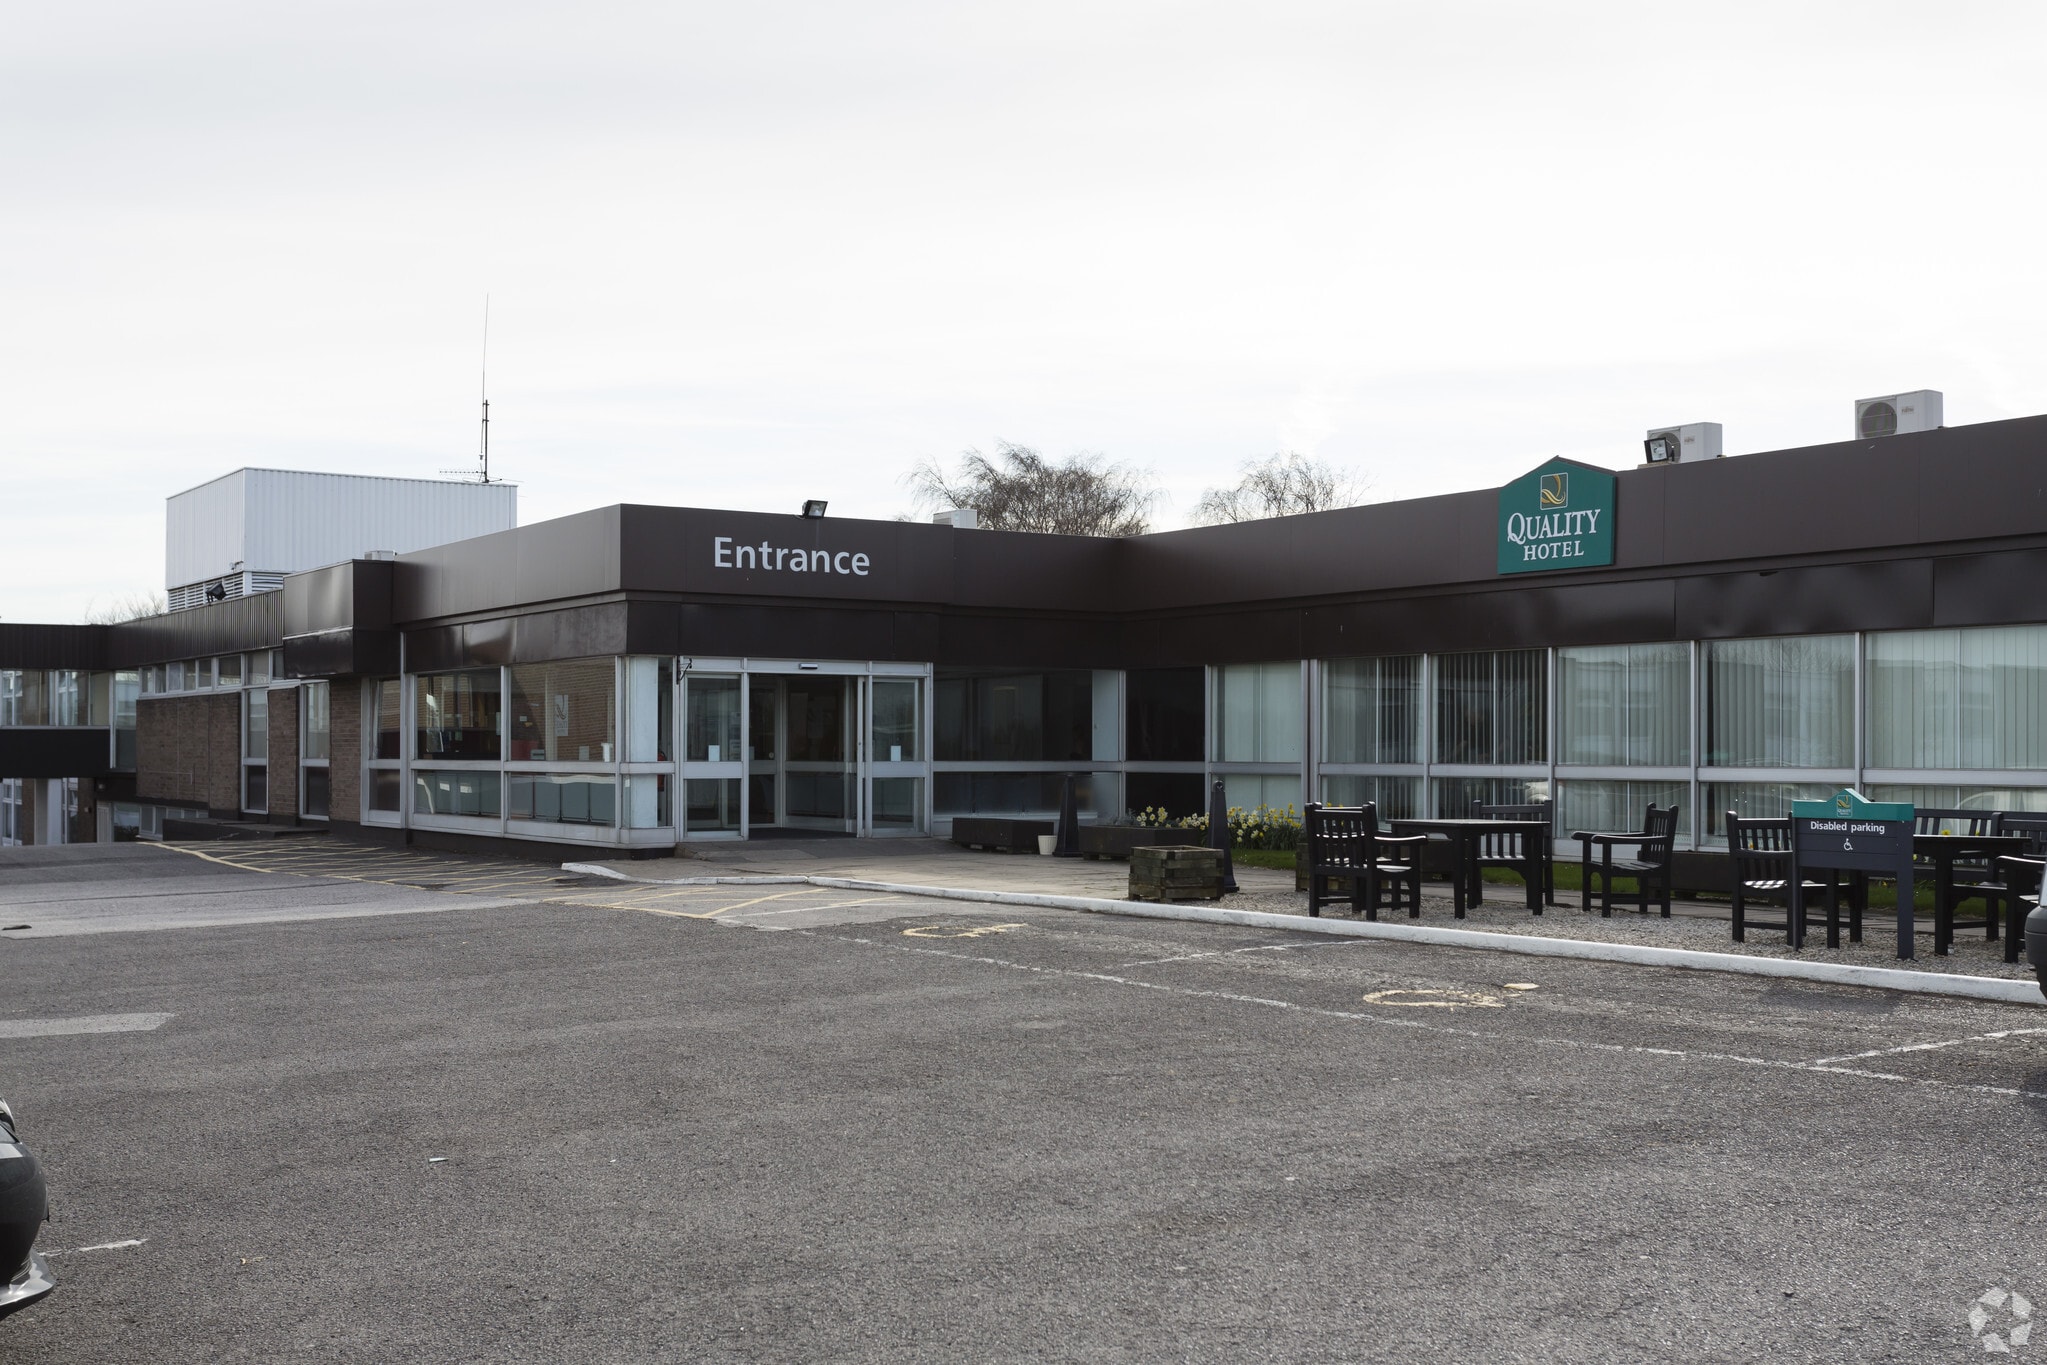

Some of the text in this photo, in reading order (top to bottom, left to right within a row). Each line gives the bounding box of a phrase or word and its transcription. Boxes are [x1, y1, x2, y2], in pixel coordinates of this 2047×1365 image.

[1507, 509, 1601, 545] QUALITY
[714, 536, 870, 576] Entrance
[1523, 540, 1584, 561] HOTEL
[1810, 821, 1885, 835] Disabled parking
